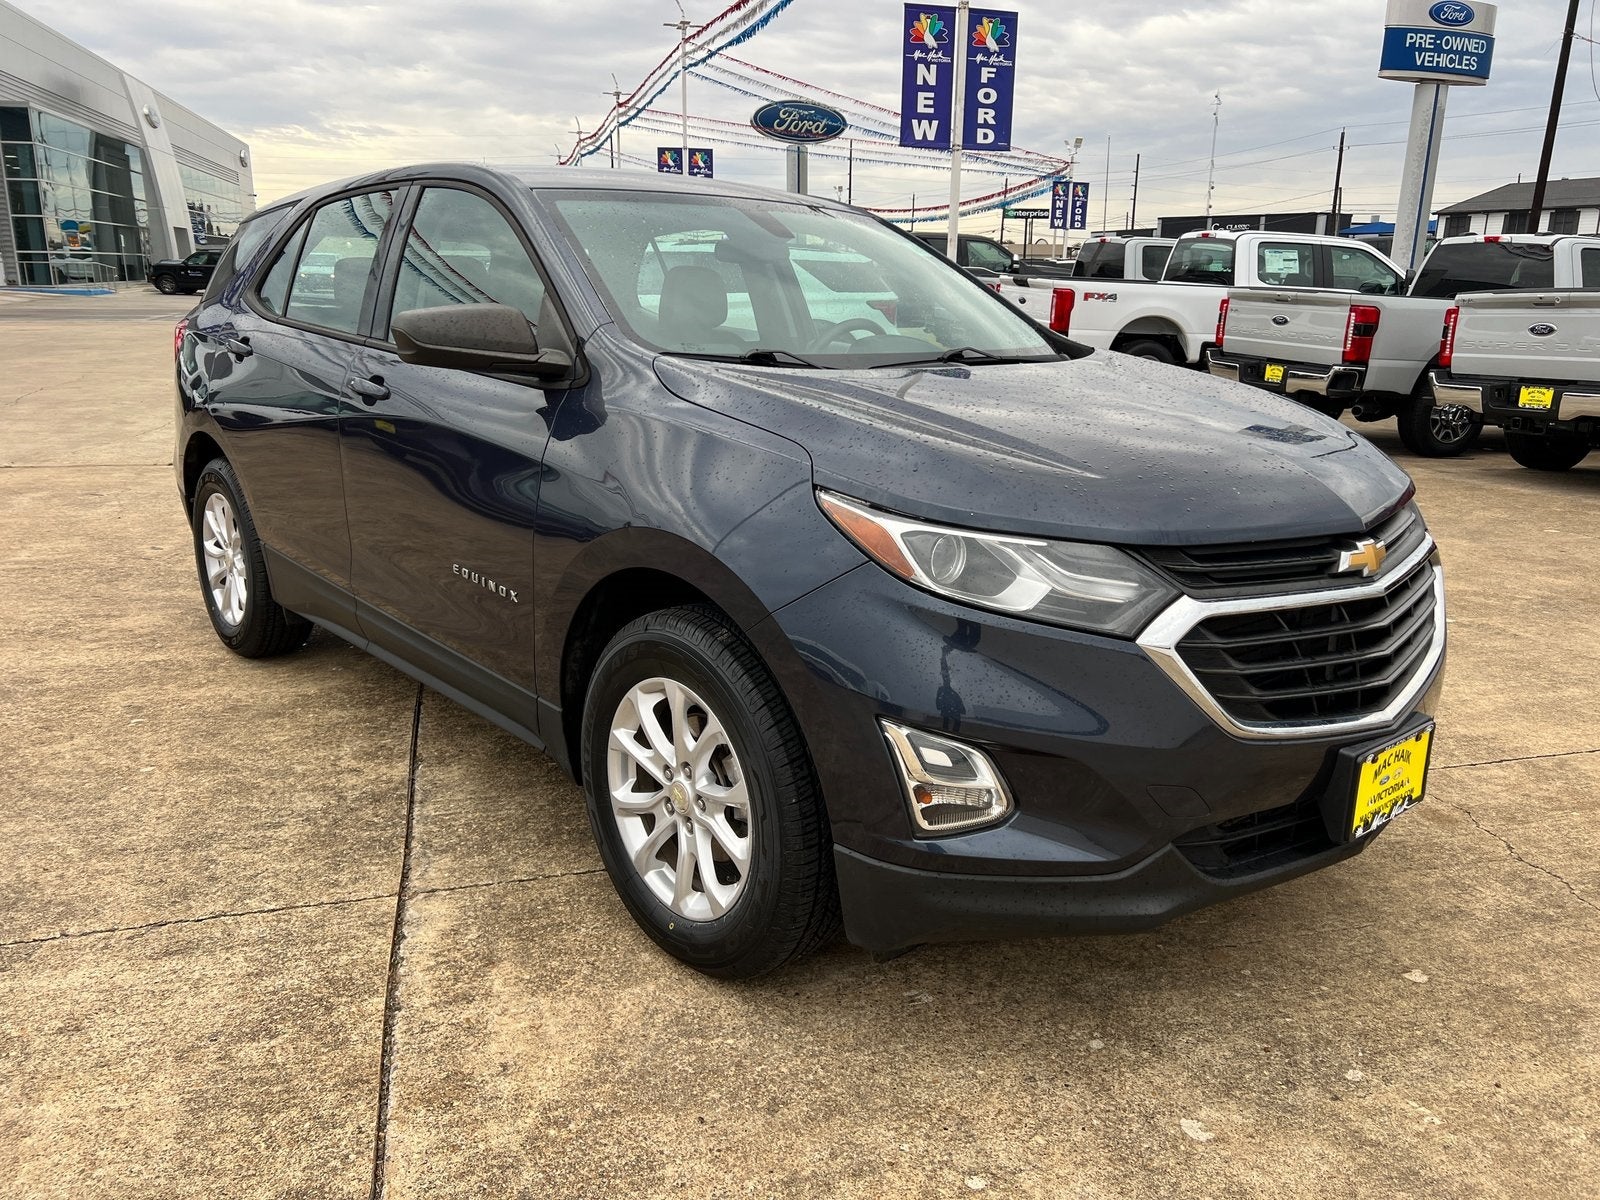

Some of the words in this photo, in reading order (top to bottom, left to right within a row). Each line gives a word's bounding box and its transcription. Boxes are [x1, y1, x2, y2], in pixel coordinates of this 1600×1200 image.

[1440, 4, 1467, 21] Ford
[1405, 33, 1487, 54] PRE-OWNED
[1415, 51, 1478, 71] VEHICLES
[911, 63, 939, 141] NEW
[976, 67, 998, 144] FORD
[773, 107, 827, 134] Ford
[1008, 209, 1049, 218] enterprise
[1054, 200, 1064, 227] NEW
[1074, 201, 1082, 228] FORD
[1083, 292, 1118, 301] FX4
[452, 563, 519, 603] EQUINOX
[1372, 753, 1393, 784] MAC
